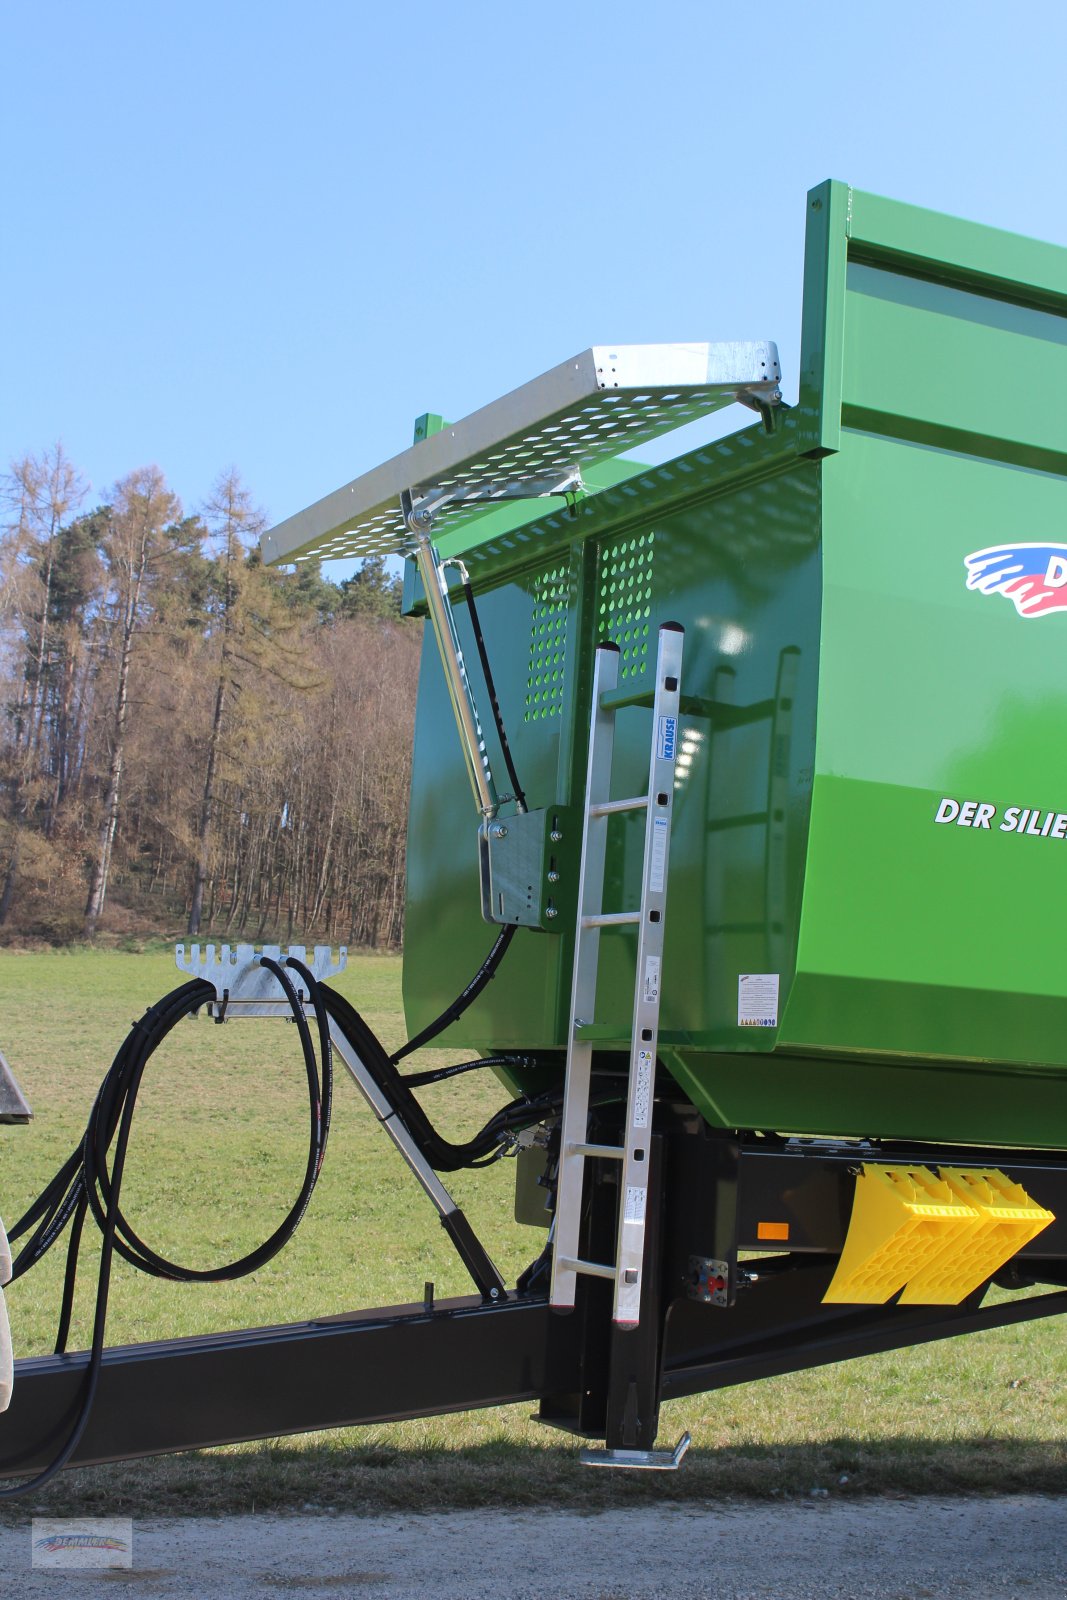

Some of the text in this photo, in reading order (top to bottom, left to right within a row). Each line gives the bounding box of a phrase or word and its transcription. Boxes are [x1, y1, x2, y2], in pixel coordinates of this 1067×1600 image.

[664, 719, 675, 759] KRAUSE
[934, 798, 1067, 839] DER SILIE
